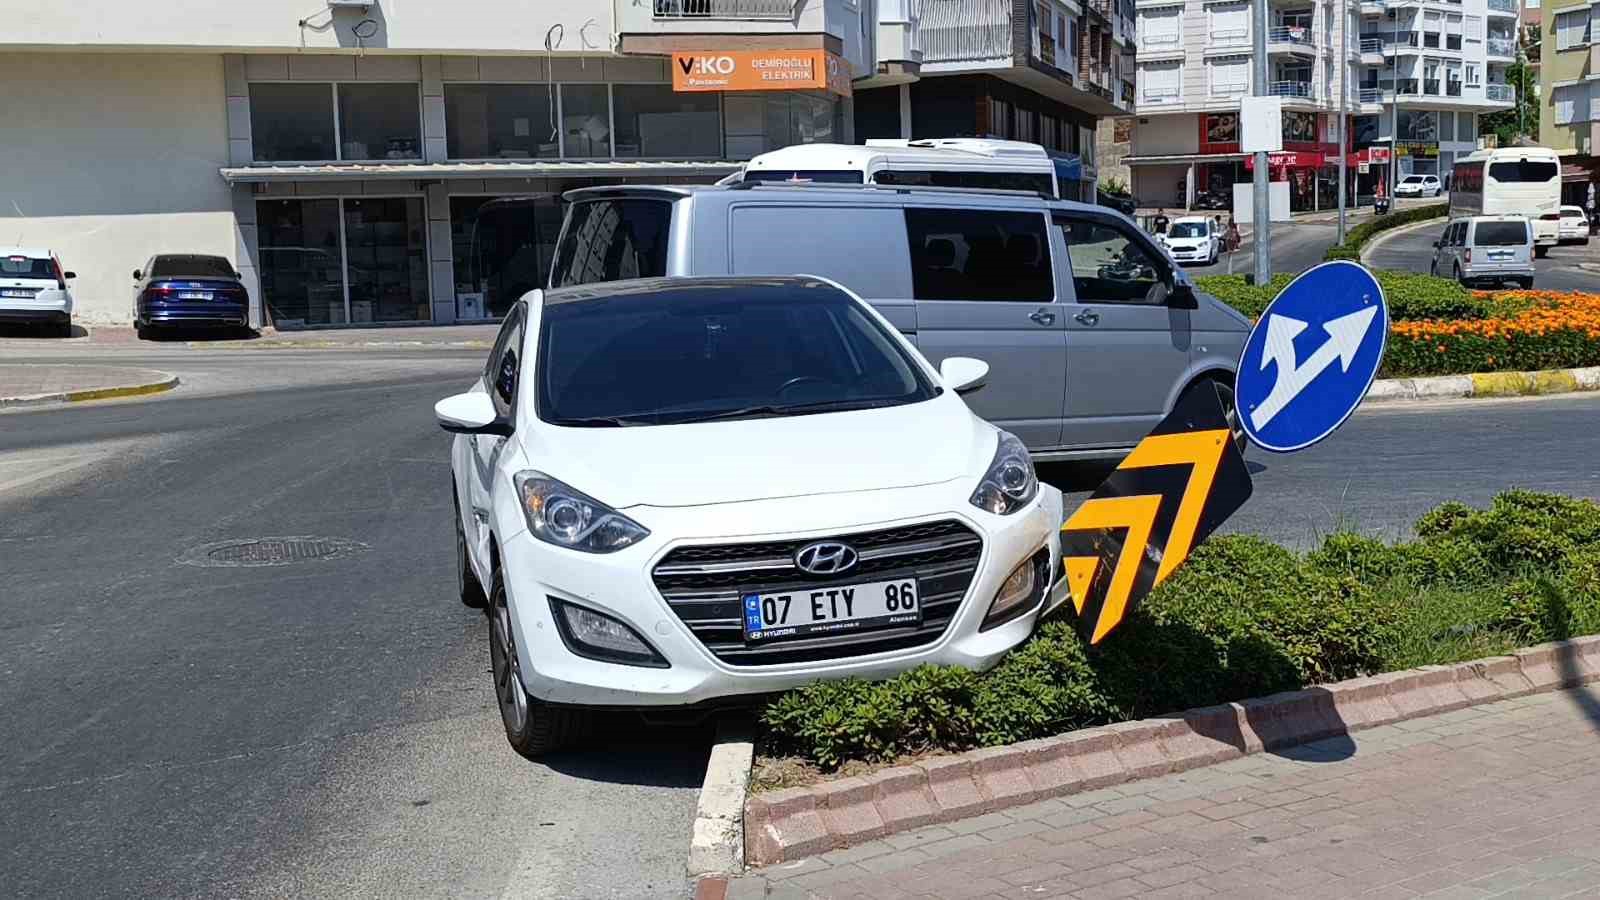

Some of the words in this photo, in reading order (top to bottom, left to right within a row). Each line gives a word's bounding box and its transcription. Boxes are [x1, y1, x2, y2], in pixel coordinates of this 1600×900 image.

[762, 596, 792, 625] 07
[811, 589, 855, 621] ETY
[885, 583, 914, 611] 86
[748, 615, 760, 625] TR
